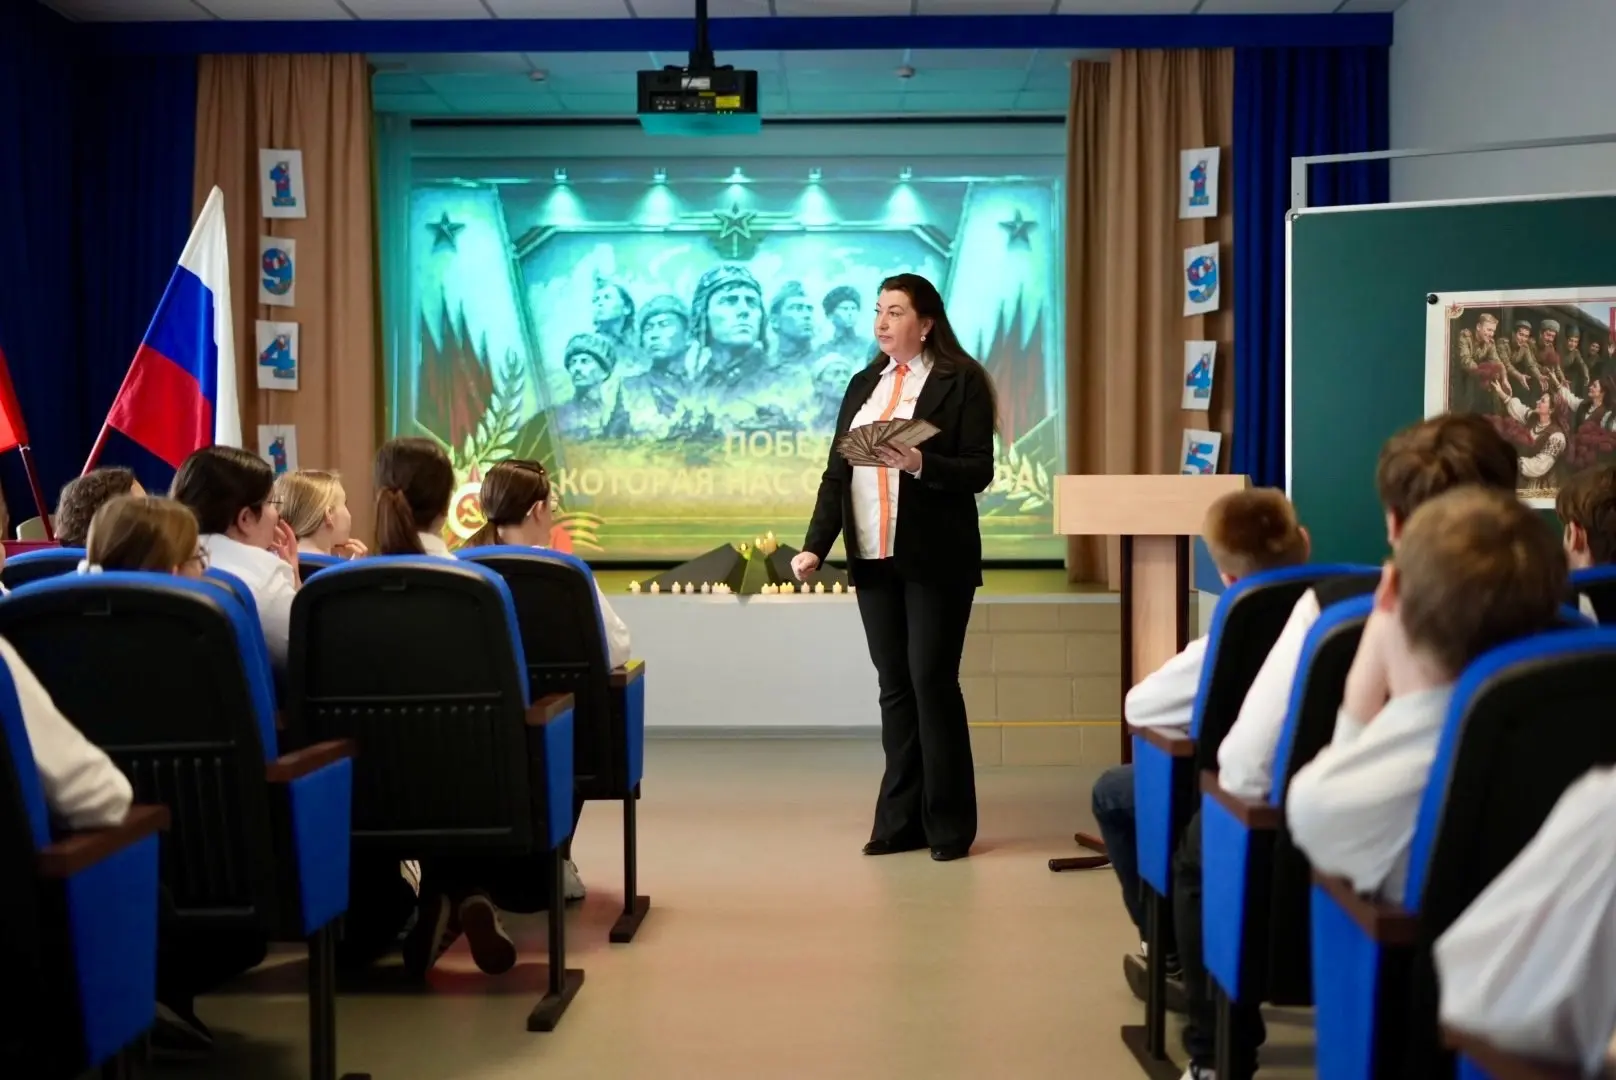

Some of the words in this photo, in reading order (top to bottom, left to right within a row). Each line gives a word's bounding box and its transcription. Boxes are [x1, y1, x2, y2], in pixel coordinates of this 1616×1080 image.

[269, 161, 297, 206] 1
[1188, 160, 1210, 206] 1
[261, 248, 293, 295] 9
[1187, 255, 1218, 303] 9
[259, 333, 295, 378] 4
[1186, 352, 1212, 398] 4
[559, 467, 714, 496] КОТОРАЯ
[728, 467, 793, 496] НАС
